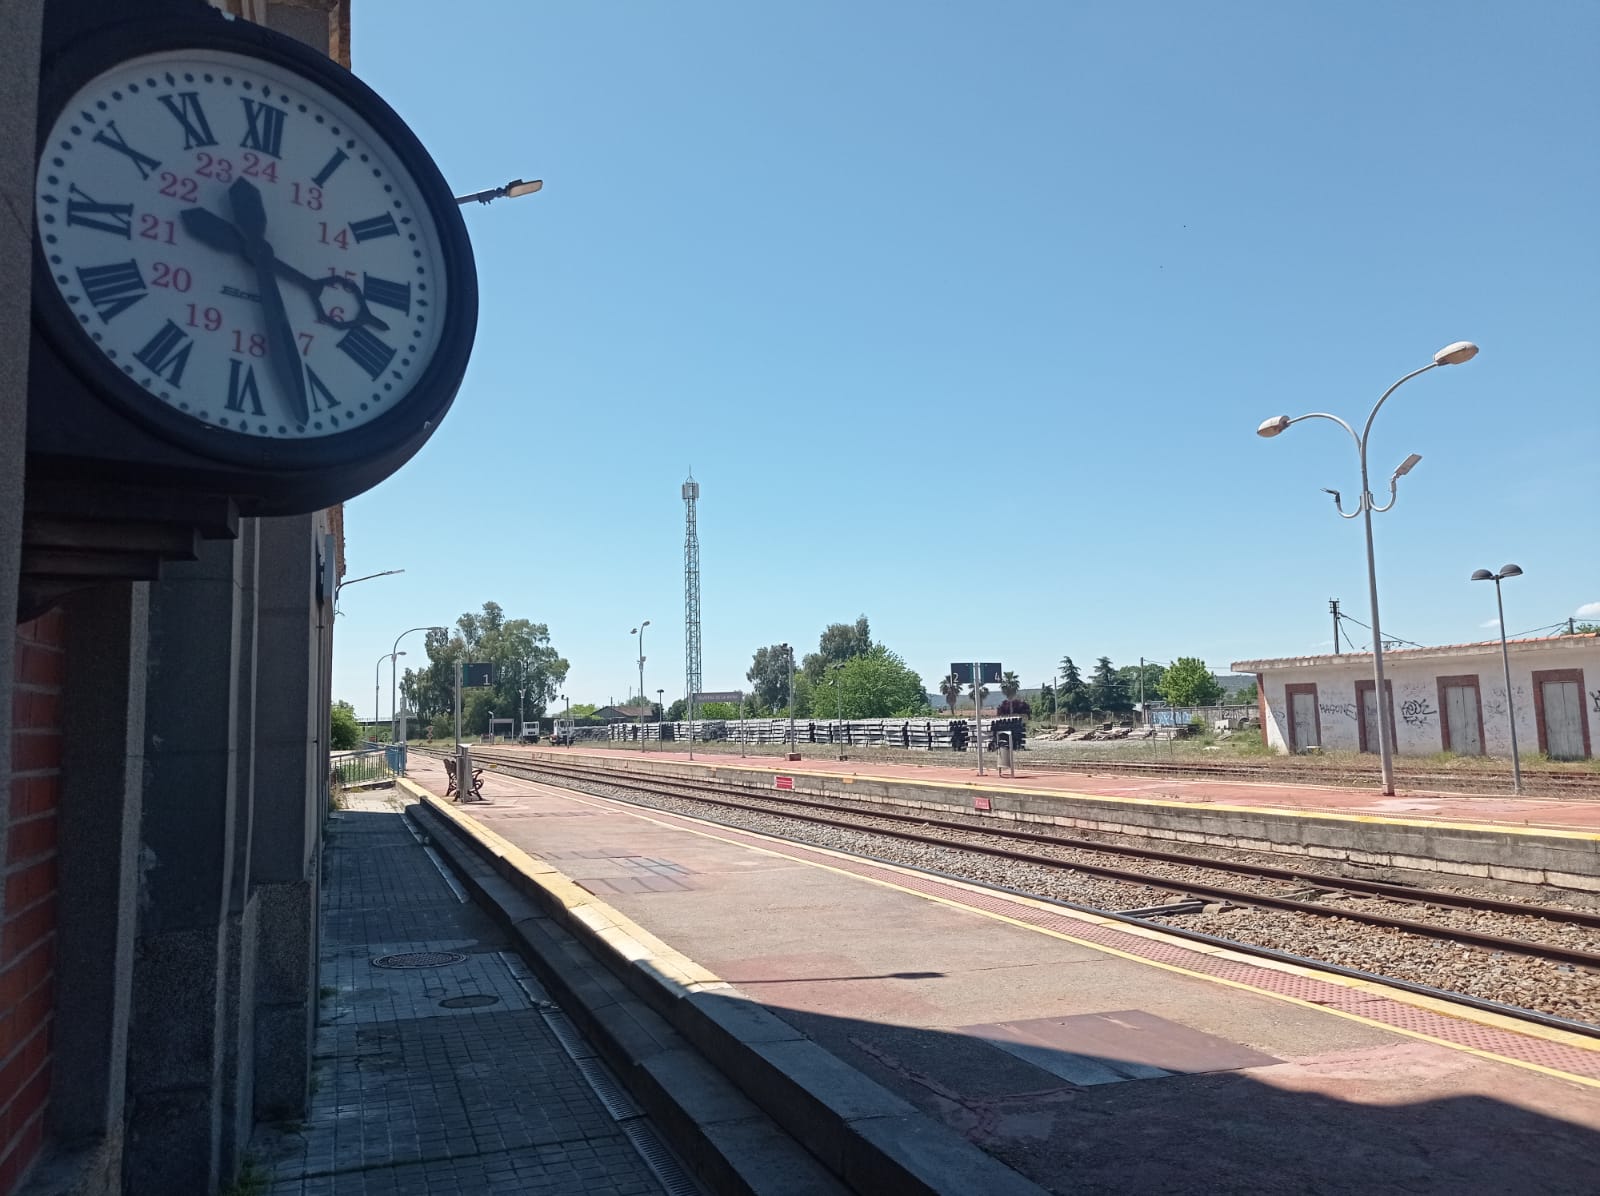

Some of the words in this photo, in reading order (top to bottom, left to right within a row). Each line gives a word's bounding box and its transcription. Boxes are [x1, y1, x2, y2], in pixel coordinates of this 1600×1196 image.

[158, 92, 218, 150] XI
[240, 97, 287, 160] XII
[93, 121, 161, 180] X
[196, 152, 233, 183] 23
[242, 153, 279, 183] 24
[312, 147, 349, 188] I
[160, 172, 199, 203] 22
[290, 182, 324, 211] 13
[68, 183, 133, 240] IX
[140, 215, 177, 245] 21
[317, 223, 349, 250] 14
[348, 211, 399, 244] II
[76, 259, 149, 325] VIII
[151, 262, 192, 293] 20
[363, 272, 411, 316] III
[186, 304, 223, 332] 19
[133, 318, 194, 389] VII
[232, 330, 265, 358] 18
[298, 334, 314, 356] 7
[337, 328, 397, 382] IIII
[224, 358, 265, 416] VI
[305, 363, 341, 413] V
[482, 674, 490, 685] 1
[953, 672, 959, 682] 2
[994, 671, 1001, 682] 4
